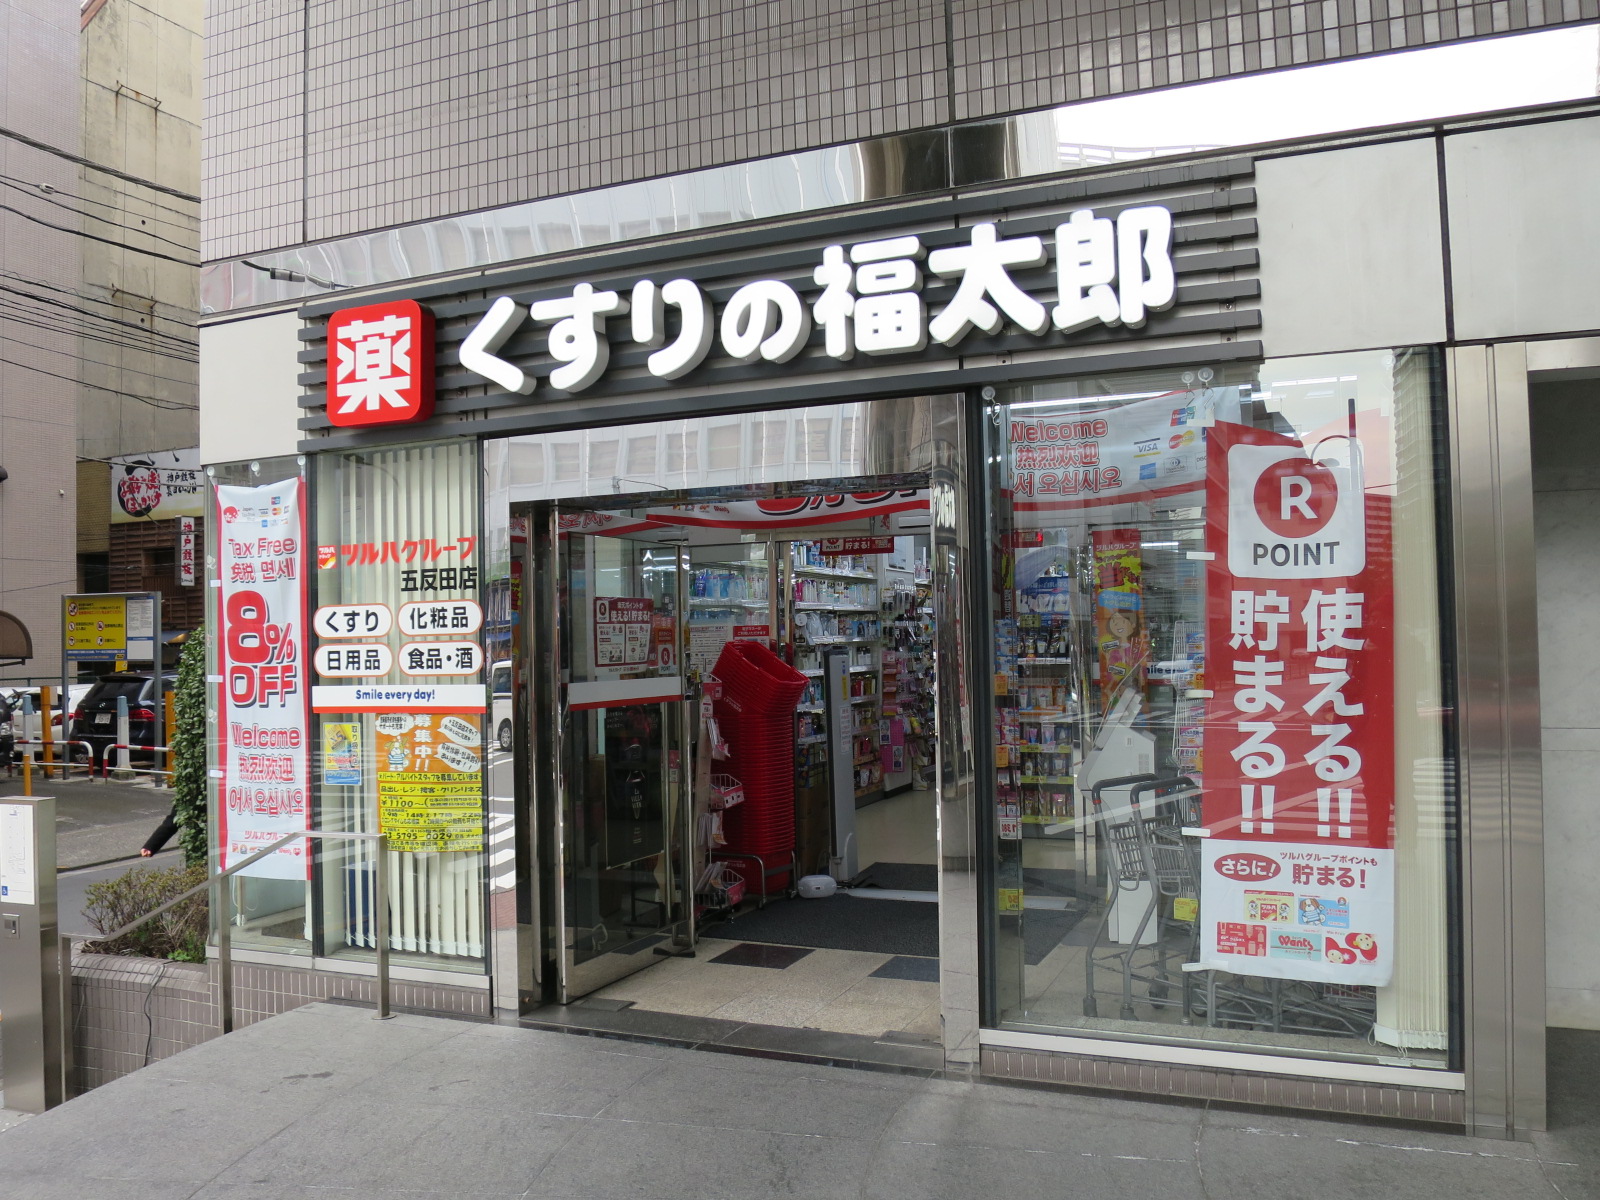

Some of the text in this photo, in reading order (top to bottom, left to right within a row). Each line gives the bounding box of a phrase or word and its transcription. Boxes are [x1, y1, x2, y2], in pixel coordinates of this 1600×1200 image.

[458, 205, 1175, 394] くすりの福太郎
[335, 314, 411, 413] 薬
[1016, 441, 1100, 470] 热烈欢迎
[1137, 443, 1159, 453] VISA
[1038, 466, 1122, 495] 오십시오
[1279, 475, 1319, 521] R
[228, 537, 297, 558] Tax Free
[341, 535, 477, 566] ツルハグループ
[845, 541, 870, 550] 貯まる!
[1096, 542, 1137, 552] ツルハグループ
[1253, 541, 1341, 567] POINT
[260, 556, 296, 582] 면세
[400, 566, 478, 592] 五反田店
[226, 590, 296, 665] 8%
[325, 609, 379, 633] くすり
[409, 606, 469, 630] 化粧品
[610, 610, 650, 622] 使える!貯まる!
[327, 649, 381, 671] 日用品
[408, 647, 473, 670] 食品・酒
[229, 664, 297, 709] OFF
[355, 689, 435, 702] Smile every day!
[1228, 588, 1291, 835] 貯まる!!
[1300, 587, 1366, 839] 使える!!
[231, 722, 301, 749] Welcome
[413, 714, 433, 771] 募集中!!
[238, 752, 295, 783] 热烈欢迎
[229, 786, 304, 817] 어서 오십시오
[1220, 858, 1278, 877] さらに!
[1280, 852, 1378, 867] ツルハグループポイントも
[1291, 863, 1368, 889] 貯まる!
[1278, 934, 1314, 951] Wants
